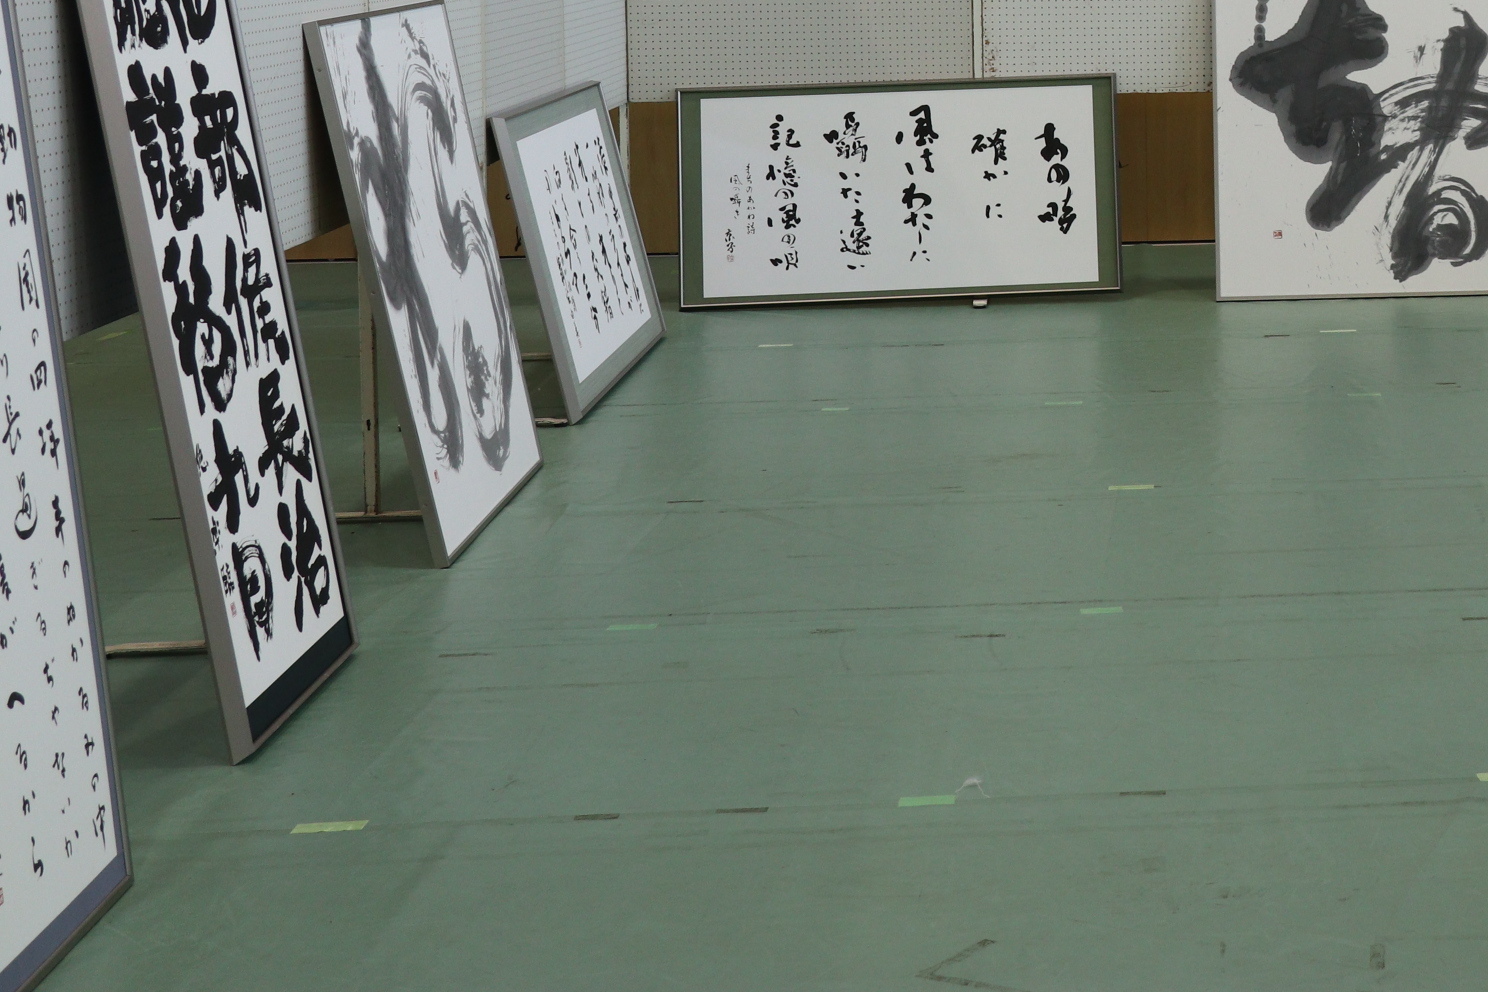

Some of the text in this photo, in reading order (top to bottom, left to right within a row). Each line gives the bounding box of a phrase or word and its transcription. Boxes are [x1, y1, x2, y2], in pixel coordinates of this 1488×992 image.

[971, 127, 1009, 220] 確かに
[1035, 122, 1077, 234] あの時
